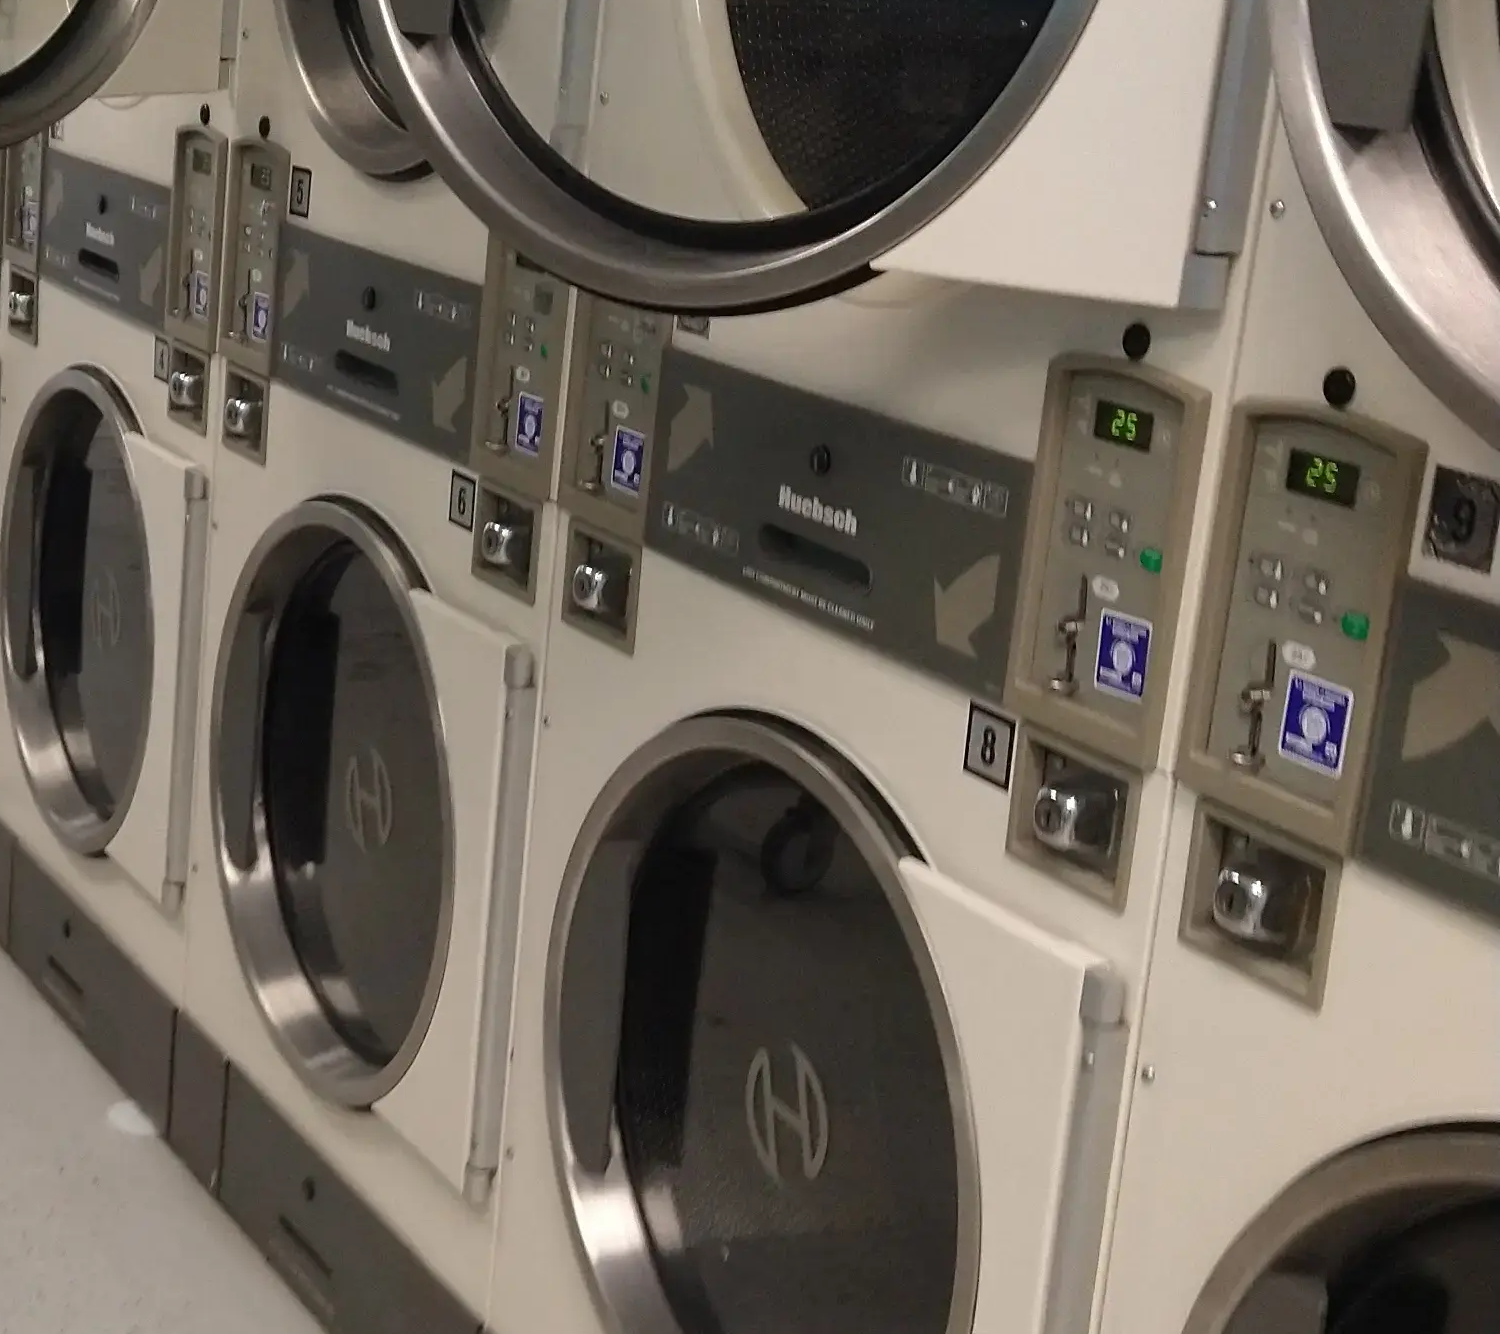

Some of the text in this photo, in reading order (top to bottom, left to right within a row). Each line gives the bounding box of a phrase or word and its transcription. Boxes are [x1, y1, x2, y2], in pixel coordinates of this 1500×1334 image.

[296, 178, 304, 205] 5
[1111, 408, 1138, 441] 25
[1306, 456, 1339, 494] 25
[457, 487, 467, 516] 6
[778, 483, 858, 537] Huebsch
[980, 726, 997, 766] 8
